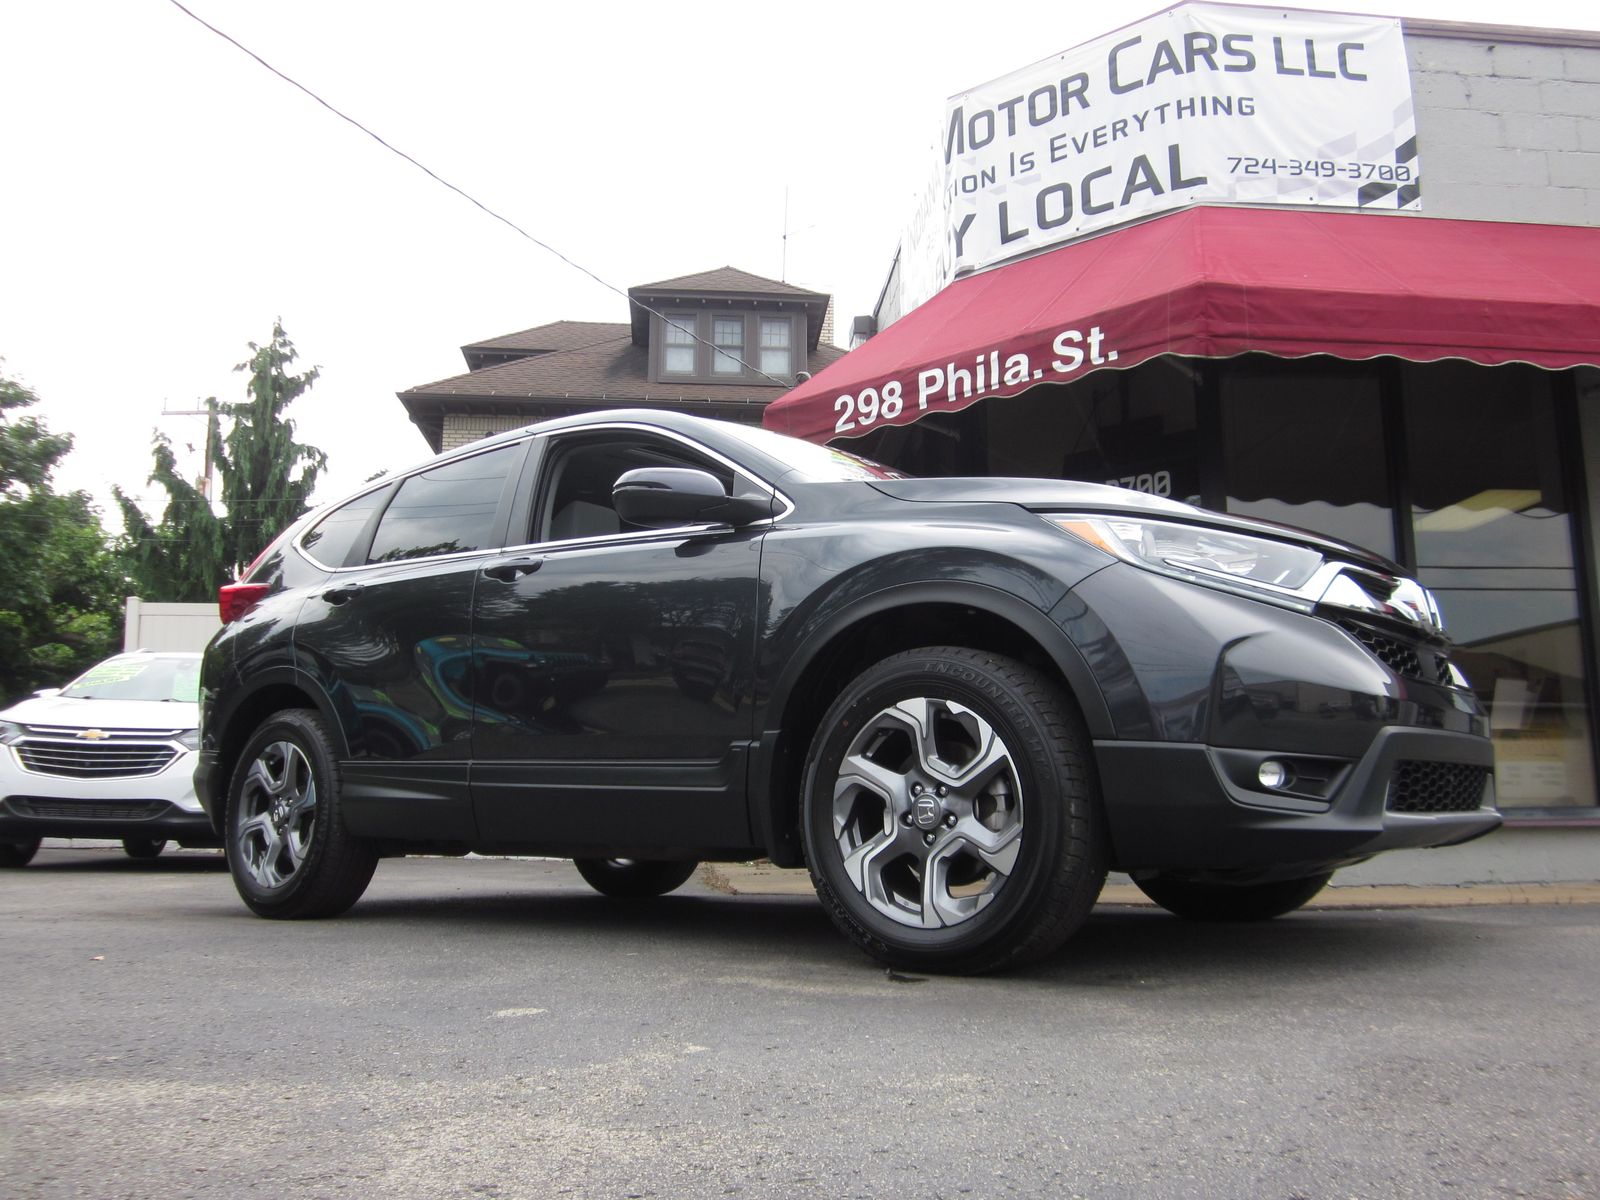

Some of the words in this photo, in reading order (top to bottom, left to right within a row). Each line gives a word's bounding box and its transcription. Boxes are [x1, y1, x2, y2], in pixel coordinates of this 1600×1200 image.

[941, 71, 1090, 166] MOTOR
[1108, 31, 1256, 96] CARS
[1273, 36, 1368, 82] LLC
[1009, 150, 1036, 175] IS
[1049, 96, 1256, 163] EVERYTHING
[999, 143, 1208, 246] LOCAL
[1226, 156, 1411, 182] 724-349-3700
[833, 379, 904, 434] 298
[917, 350, 1044, 410] Phila.
[1051, 326, 1120, 373] St.
